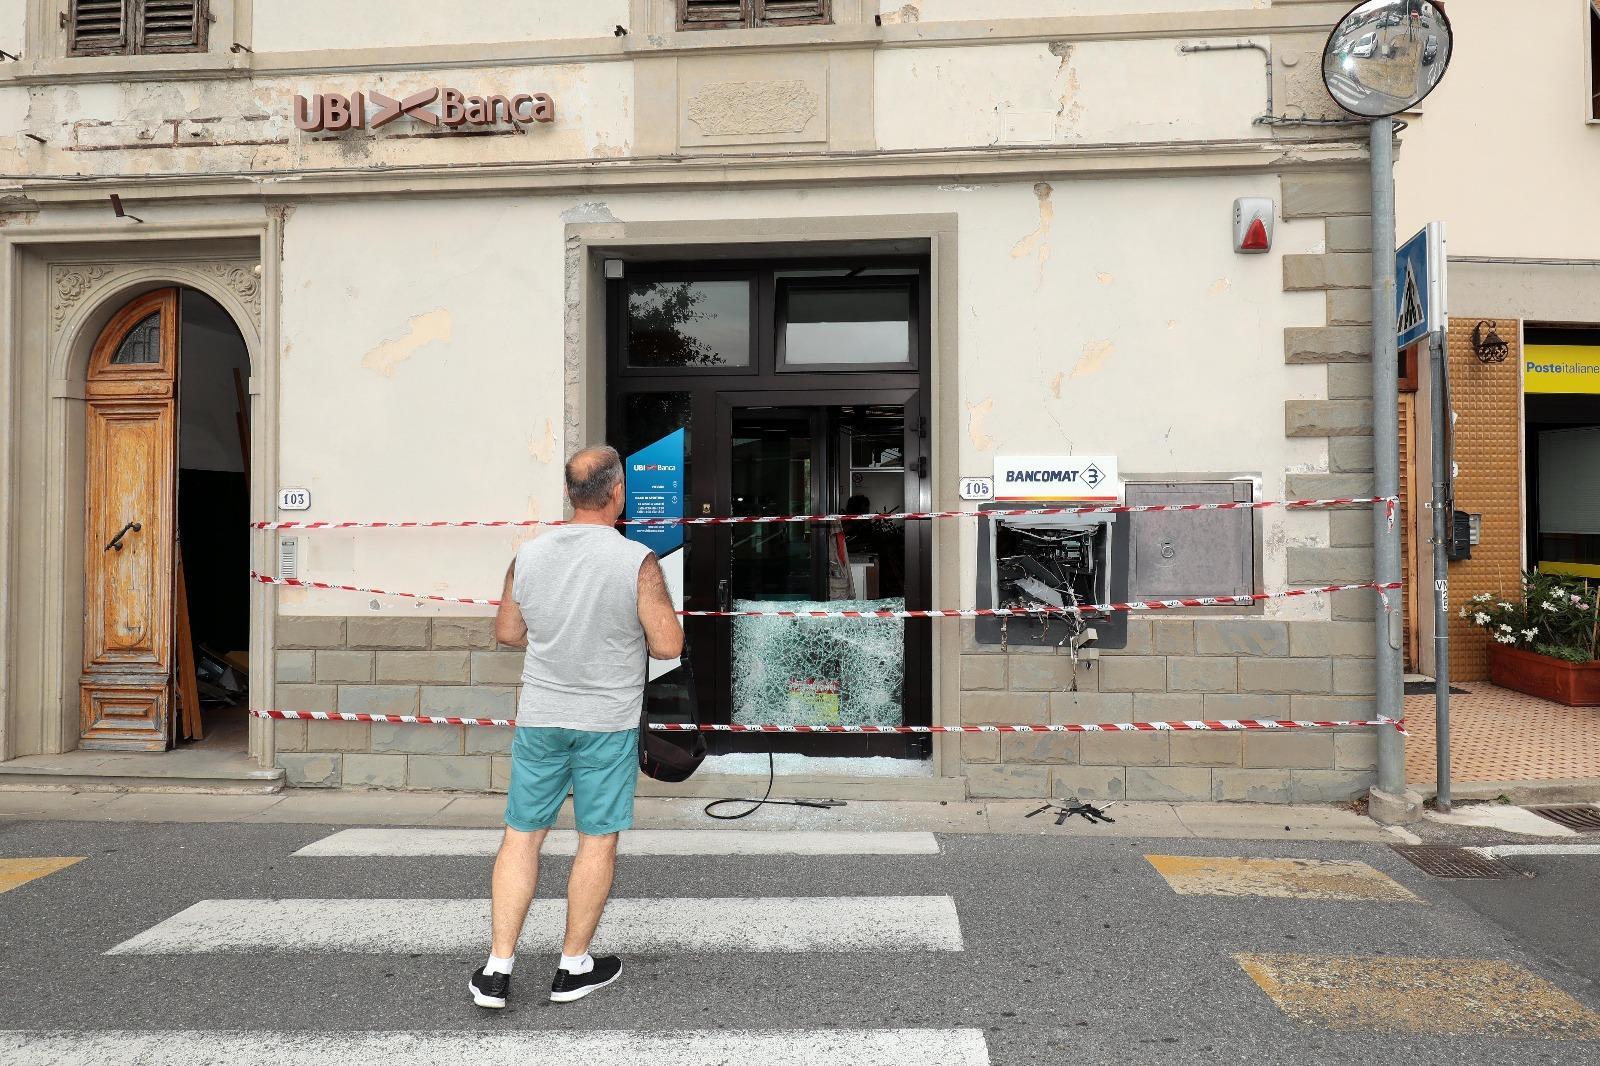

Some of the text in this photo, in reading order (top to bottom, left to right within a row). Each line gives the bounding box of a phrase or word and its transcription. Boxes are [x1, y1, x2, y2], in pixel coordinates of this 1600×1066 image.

[293, 87, 554, 132] UBI Banca
[1006, 470, 1079, 482] BANCOMAT
[965, 482, 990, 495] 105
[284, 493, 305, 505] 103
